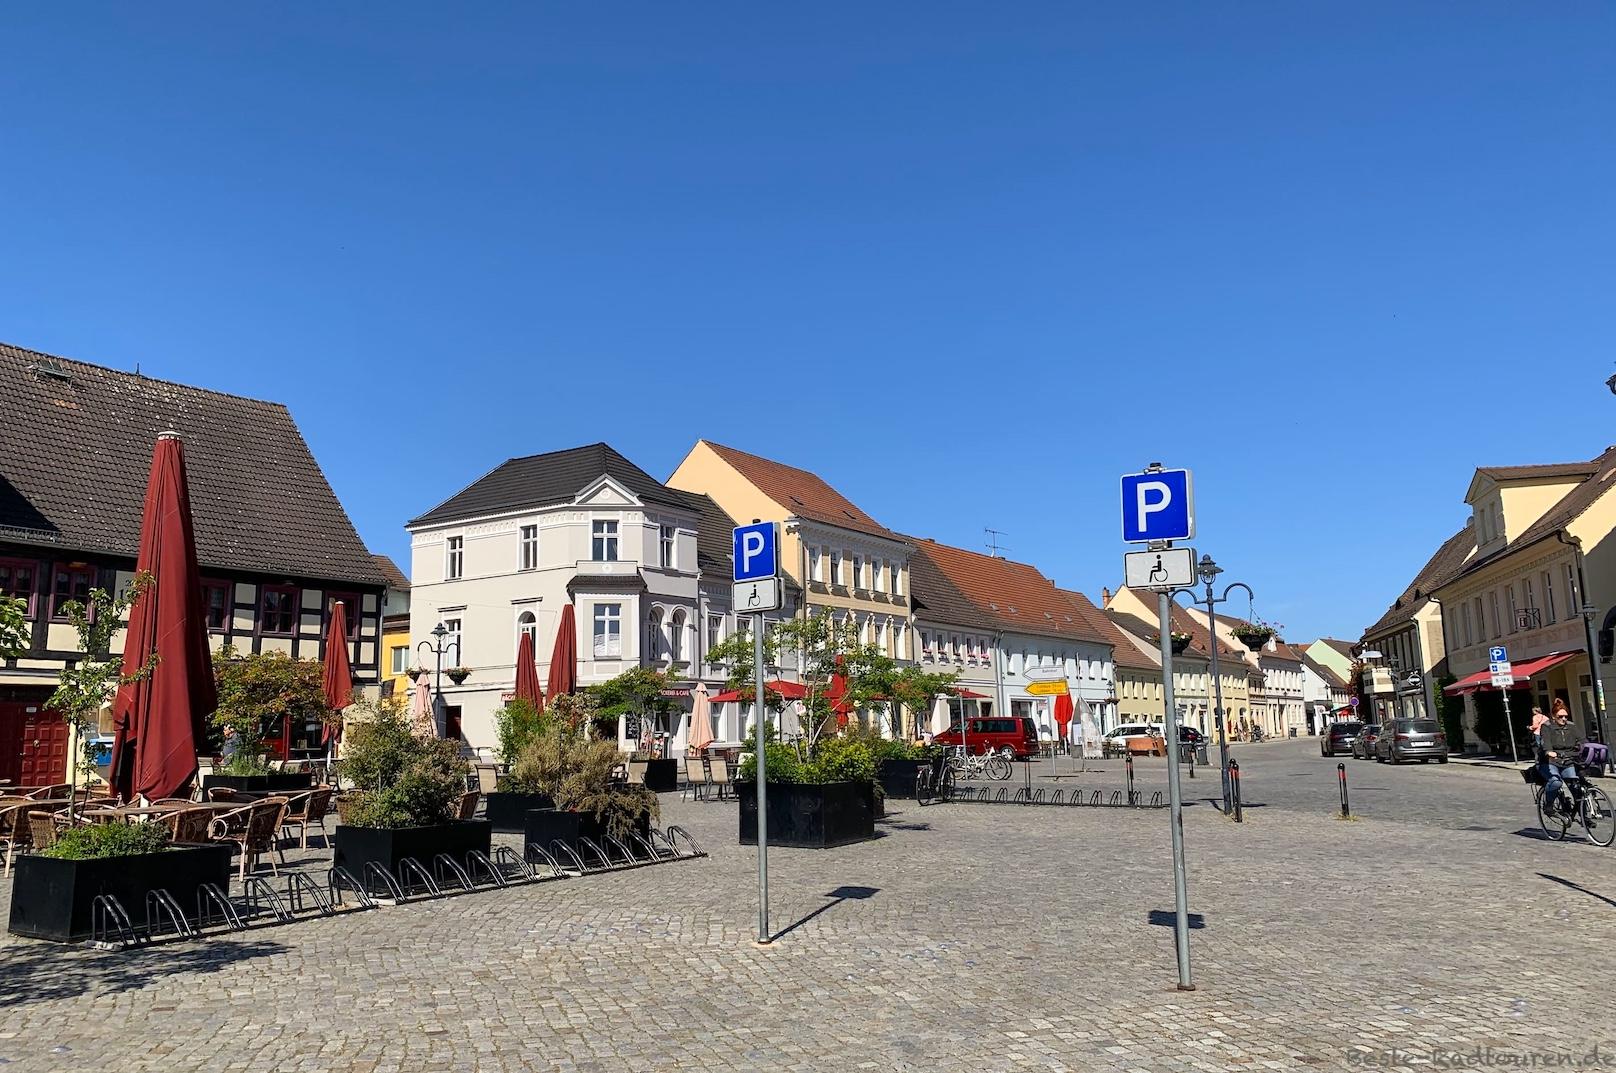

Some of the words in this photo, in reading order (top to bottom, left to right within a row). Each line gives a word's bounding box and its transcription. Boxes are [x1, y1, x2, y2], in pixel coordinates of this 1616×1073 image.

[1137, 481, 1171, 532] P
[743, 531, 765, 573] P
[1494, 649, 1502, 660] P
